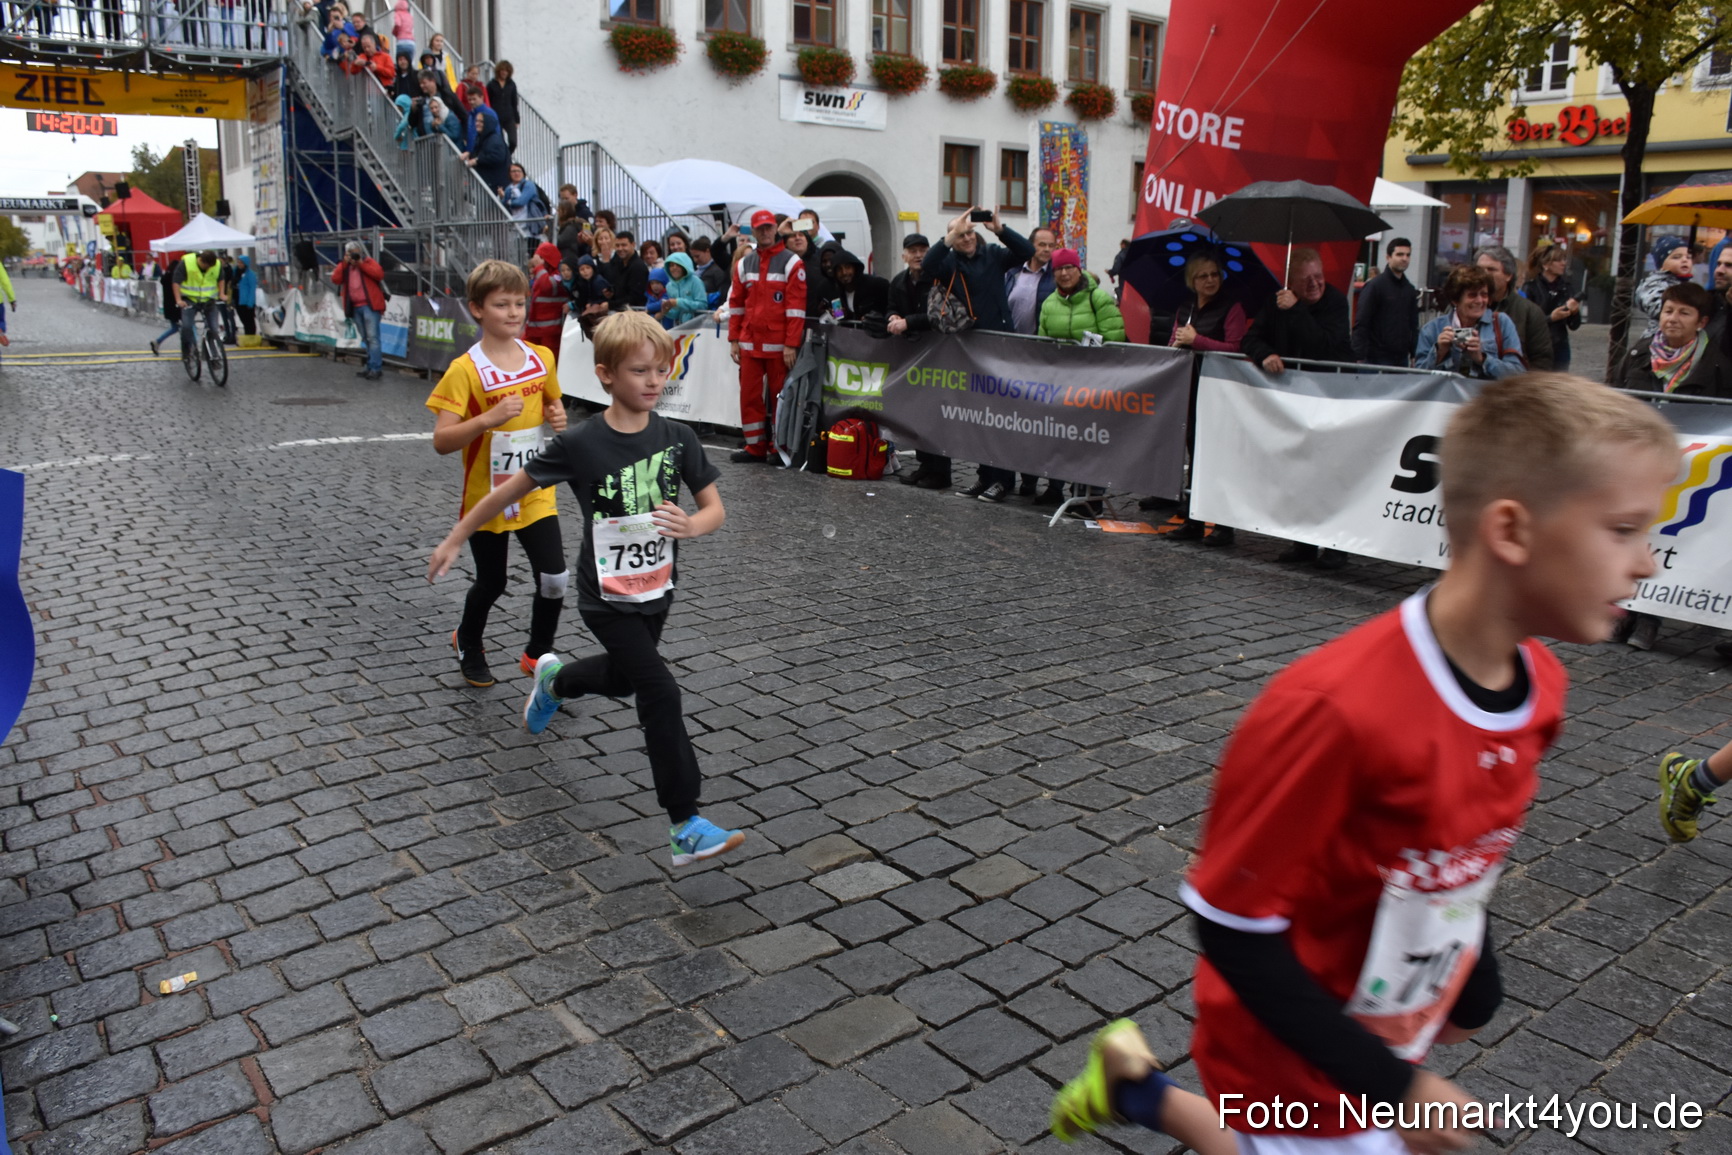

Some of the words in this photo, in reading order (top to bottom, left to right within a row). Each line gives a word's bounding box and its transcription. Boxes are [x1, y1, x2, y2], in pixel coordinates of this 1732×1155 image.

[15, 72, 105, 106] ZIEL
[803, 91, 846, 109] swn
[1155, 100, 1245, 150] STORE
[1507, 117, 1555, 142] Der
[823, 360, 885, 393] OCK
[907, 366, 967, 391] OFFICE
[971, 373, 1062, 404] INDUSTRY
[1063, 385, 1156, 416] LOUNGE
[941, 403, 1111, 445] www.bockonline.de
[1382, 500, 1446, 527] stadt
[609, 536, 667, 571] 7392
[1632, 580, 1732, 615] ualität!
